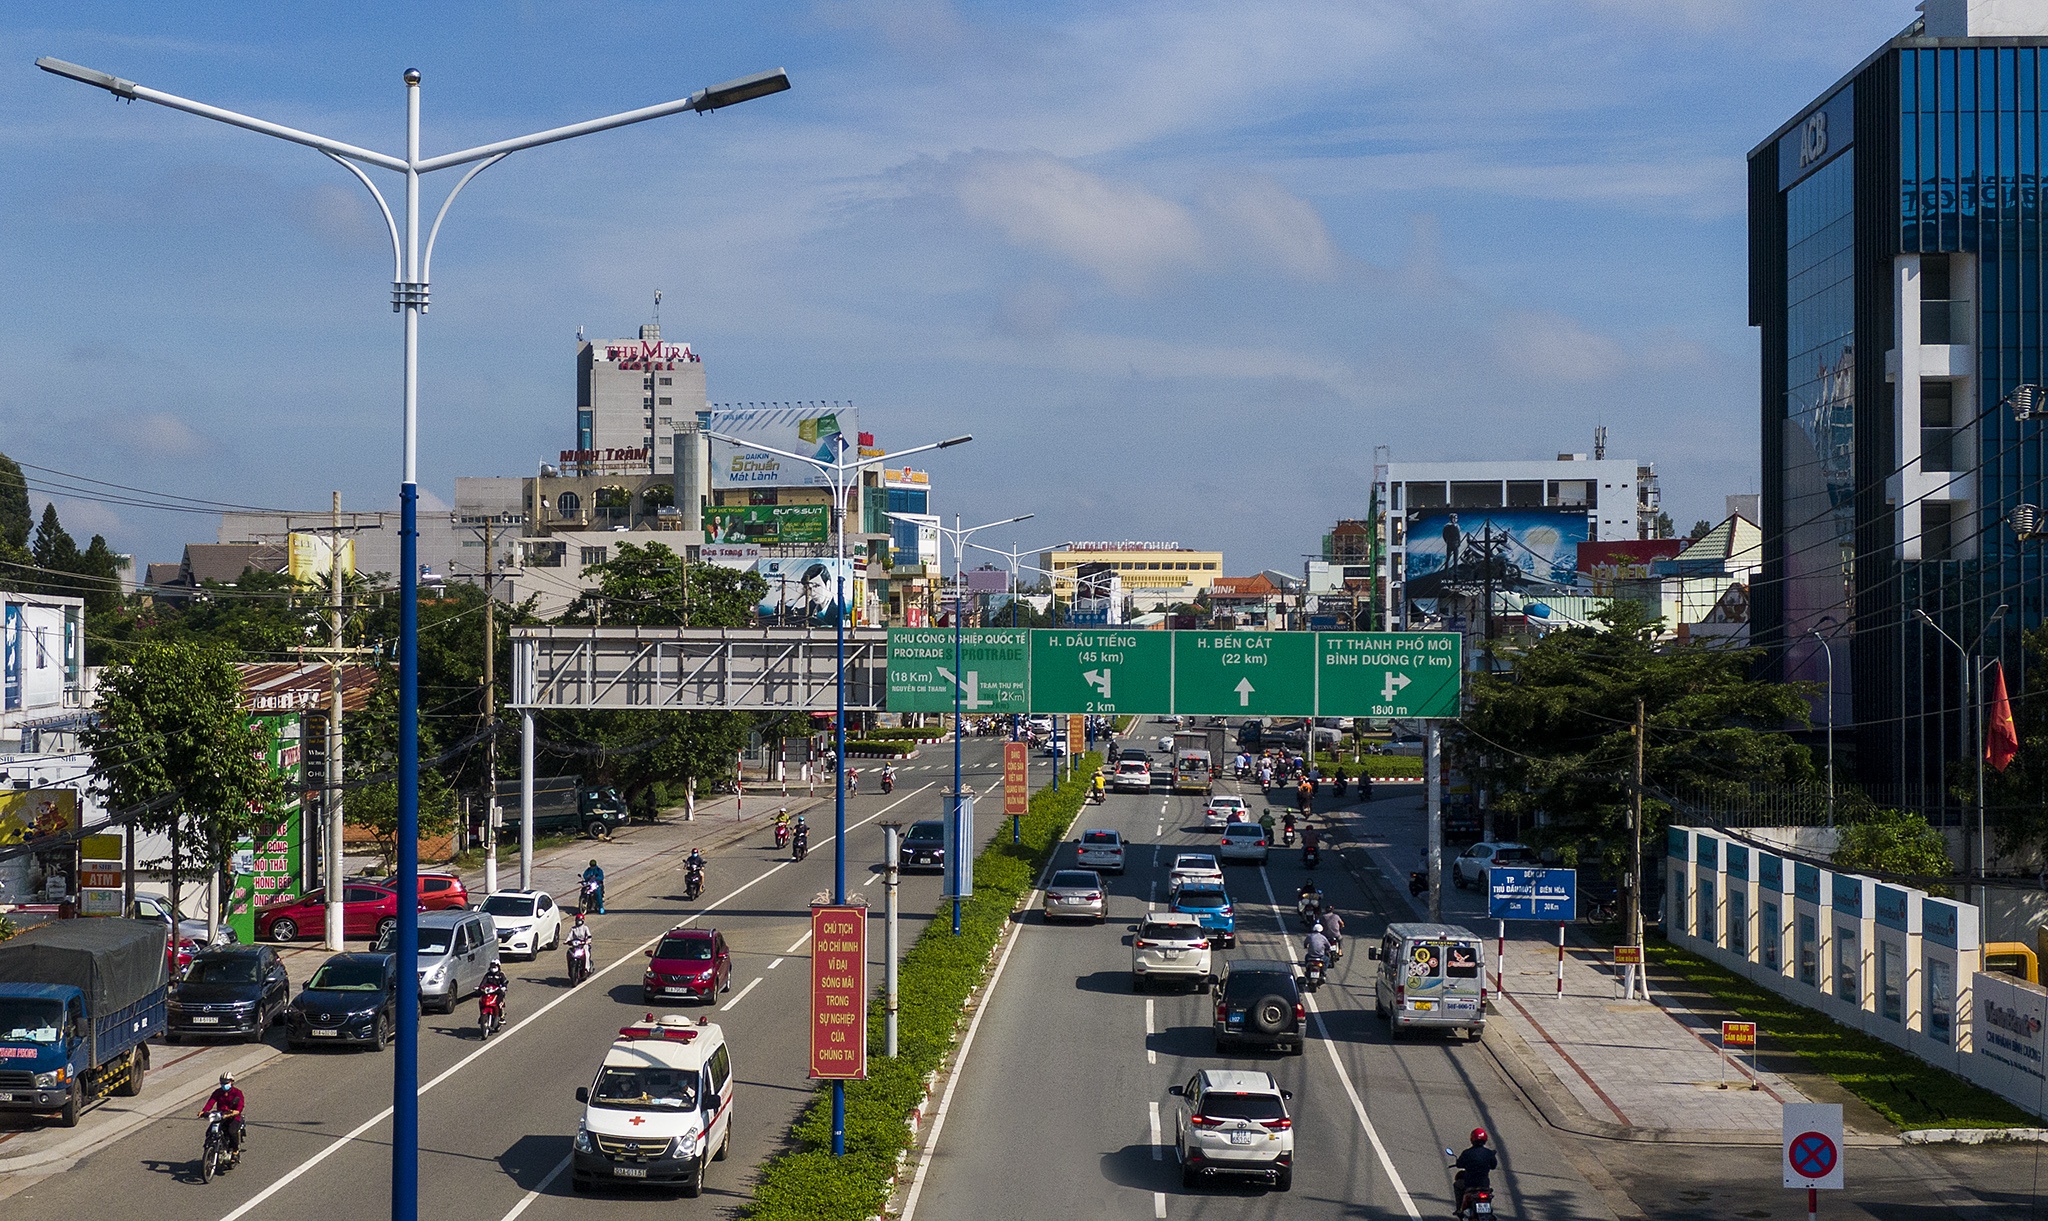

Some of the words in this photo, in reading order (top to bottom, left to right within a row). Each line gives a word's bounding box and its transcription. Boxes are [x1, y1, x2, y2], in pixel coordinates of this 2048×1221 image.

[1801, 112, 1827, 168] ACB
[605, 346, 638, 359] THE
[560, 450, 600, 461] MINH
[605, 446, 649, 462] TRÂM
[729, 472, 748, 481] Mát
[752, 472, 778, 481] Lành
[893, 634, 915, 644] KHU
[916, 632, 945, 644] CÔNG
[985, 631, 1013, 644] QUỐC
[1015, 631, 1026, 644] TẾ
[1049, 636, 1062, 647] H.
[1066, 632, 1093, 647] DẦU
[1097, 633, 1136, 647] TIẾNG
[1197, 638, 1210, 648] H.
[1214, 634, 1242, 648] BẾN
[1245, 636, 1272, 648] CÁT
[1327, 639, 1343, 650] TT
[1347, 637, 1392, 650] THÀNH
[1396, 636, 1424, 651] PHỐ
[1427, 637, 1452, 650] MỚI
[894, 648, 943, 658] PROTRADE
[1079, 652, 1097, 664] (45
[1101, 652, 1124, 664] km)
[1222, 654, 1240, 666] (22
[1244, 654, 1268, 666] km)
[1326, 652, 1358, 665] BÌNH
[1362, 653, 1409, 665] DƯƠNG
[1413, 655, 1425, 668] (7
[1429, 655, 1453, 668] km)
[891, 671, 908, 682] (18
[910, 671, 933, 683] Km)
[1012, 681, 1024, 689] PHÍ
[1086, 702, 1093, 712] 2
[1097, 702, 1115, 712] km
[1371, 705, 1393, 715] 1800
[1396, 707, 1407, 715] m
[267, 840, 289, 854] CÔNG
[269, 855, 288, 871] THẤT
[90, 873, 113, 886] ATM
[254, 872, 276, 889] HÒNG
[1493, 883, 1505, 893] THỦ
[823, 921, 837, 934] CHỦ
[838, 923, 854, 937] TỊCH
[818, 939, 828, 952] HỒ
[829, 939, 840, 952] CHÍ
[842, 941, 859, 952] MINH
[828, 957, 836, 970] VĨ
[836, 959, 848, 973] ĐẠI
[821, 975, 841, 988] SỐNG
[842, 975, 855, 988] MÃI
[826, 995, 849, 1006] TRONG
[819, 1012, 830, 1027] SỰ
[831, 1012, 856, 1027] NGHIỆP
[830, 1029, 846, 1042] CỦA
[819, 1047, 843, 1060] CHÚNG
[844, 1050, 855, 1060] TA!
